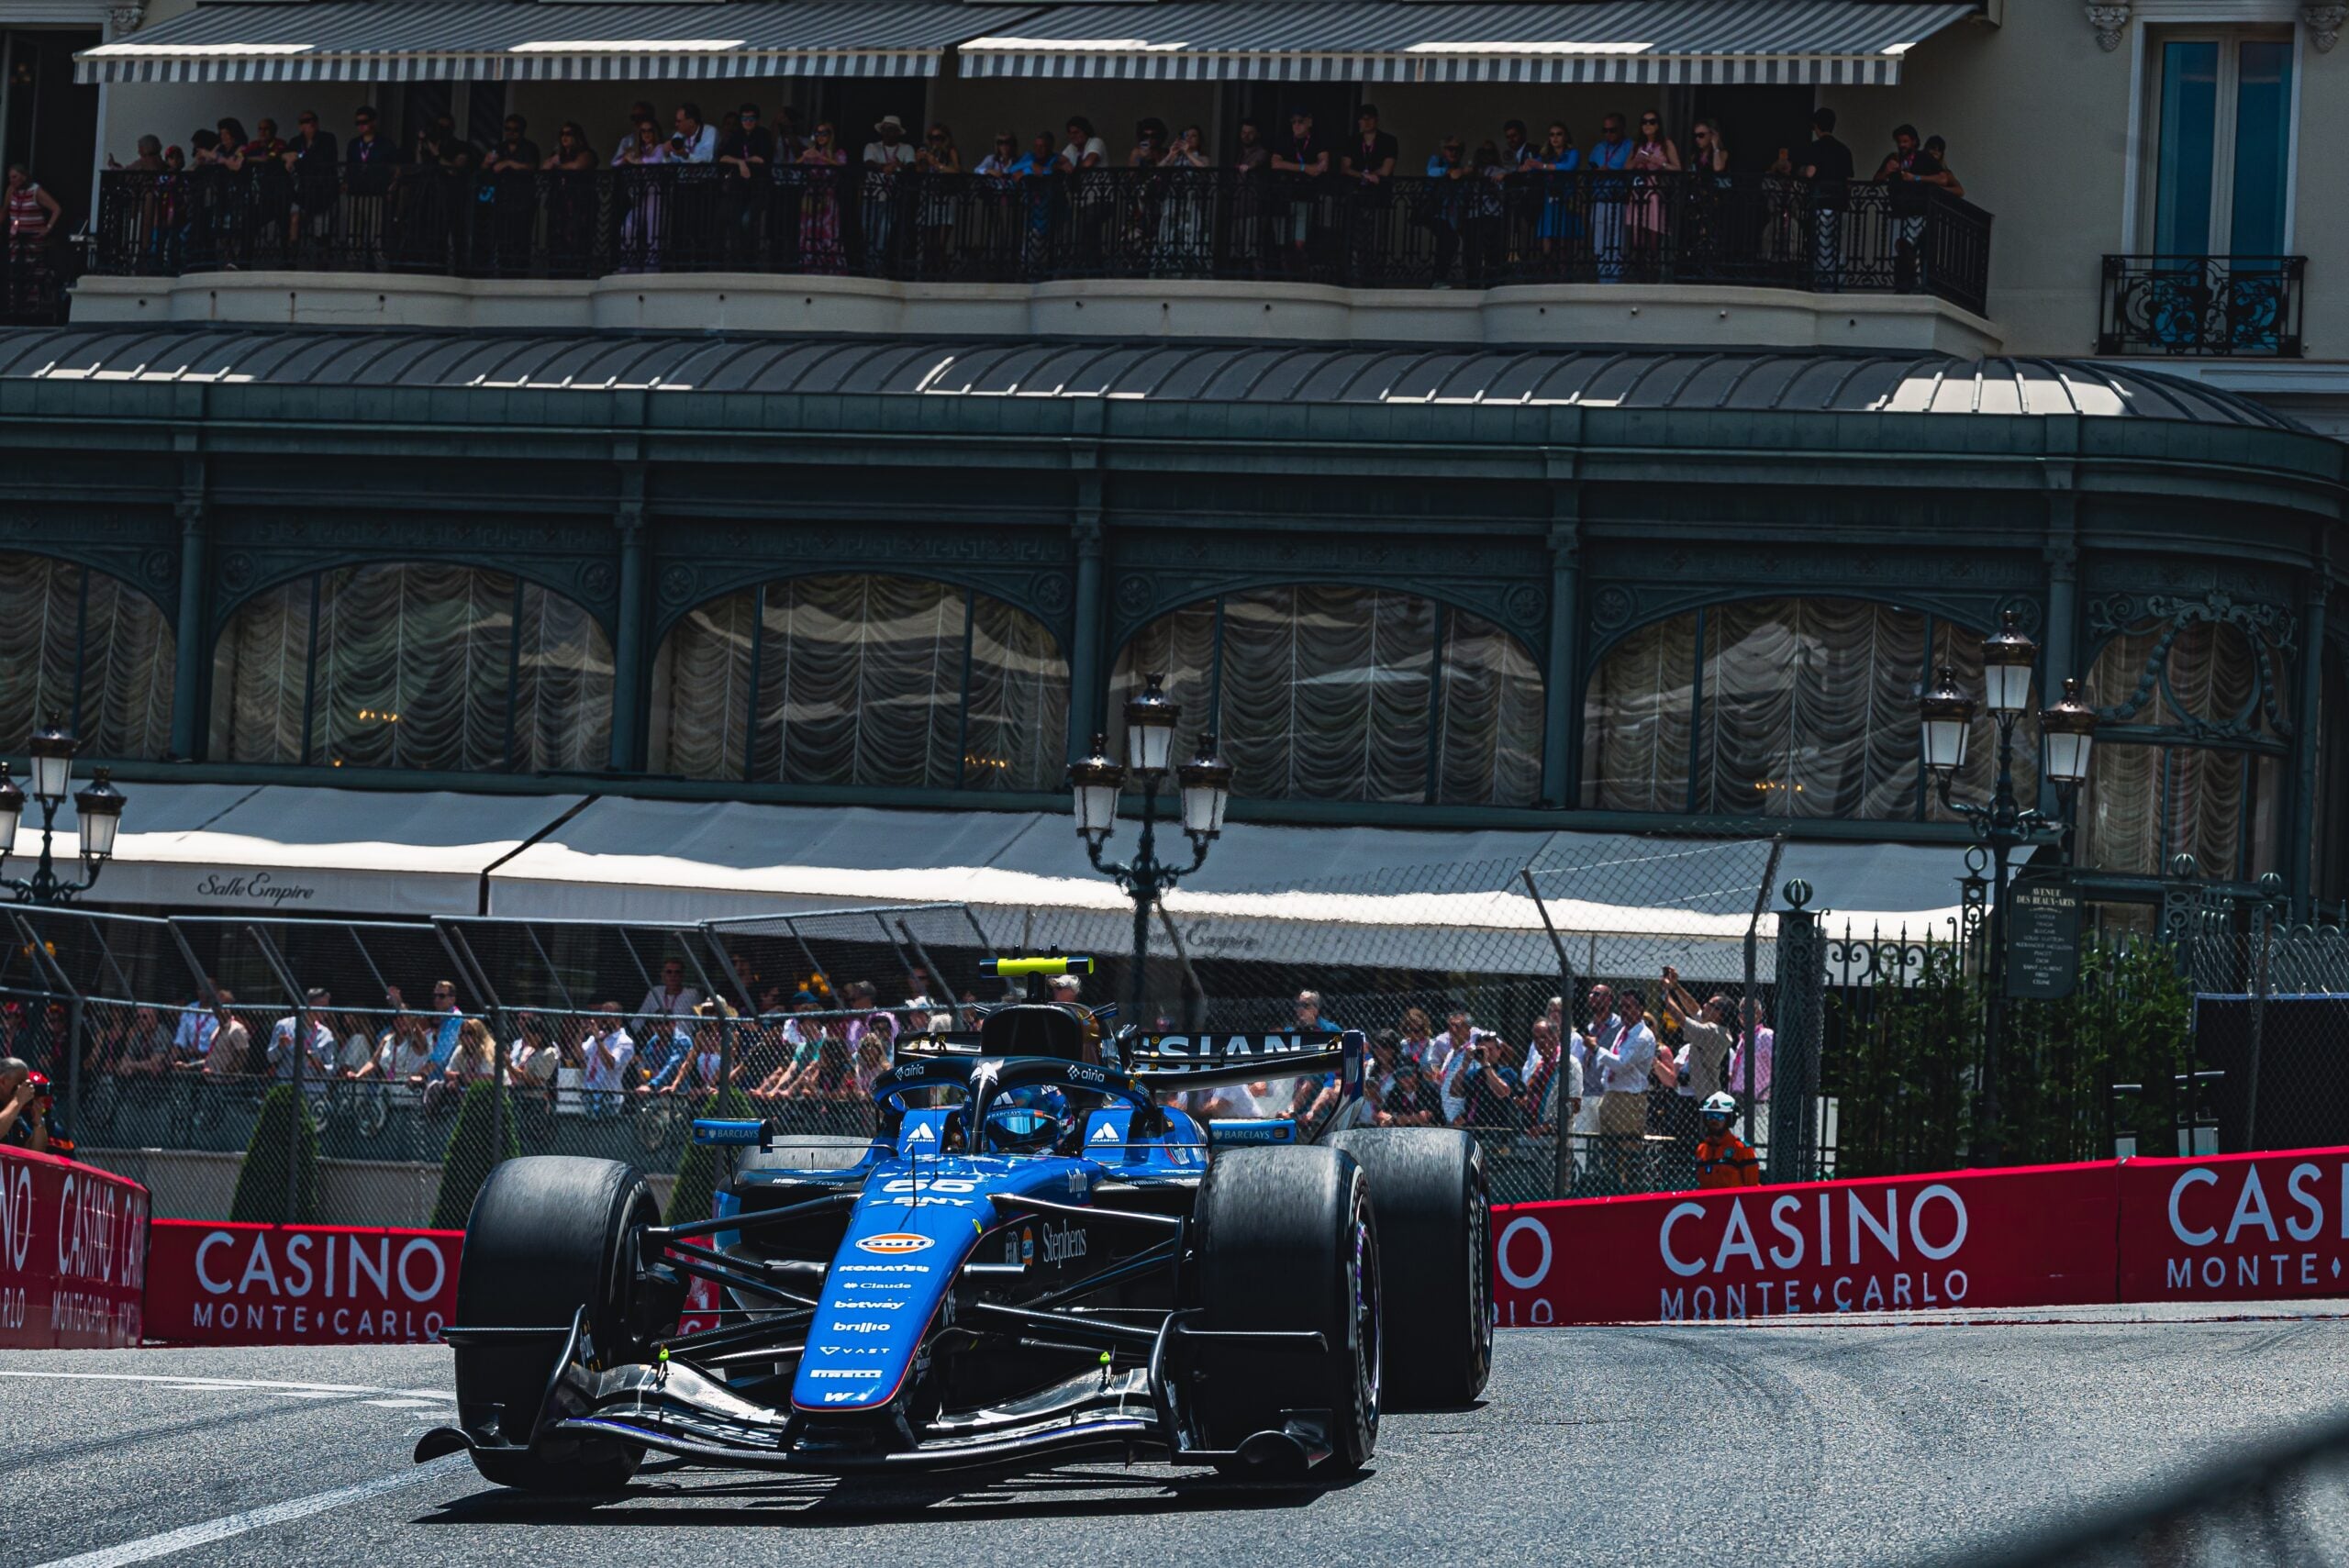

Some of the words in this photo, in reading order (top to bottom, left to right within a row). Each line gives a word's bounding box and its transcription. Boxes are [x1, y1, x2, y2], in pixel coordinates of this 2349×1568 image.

[196, 874, 245, 895] Salle
[247, 872, 315, 906] Empire
[2032, 888, 2061, 897] AVENUE
[2016, 895, 2031, 904] DES
[2032, 896, 2076, 906] BEAUX-ARTS
[904, 1063, 925, 1077] airia
[1081, 1068, 1105, 1083] airia
[718, 1129, 759, 1139] BARCLAYS
[1224, 1129, 1270, 1140] BARCLAYS
[882, 1179, 976, 1193] 55
[893, 1196, 974, 1207] BNY
[59, 1173, 115, 1277] CASINO
[1660, 1184, 1968, 1276] CASINO
[862, 1239, 929, 1249] Gulf
[1042, 1218, 1087, 1269] Stephens
[195, 1230, 446, 1302] CASINO
[839, 1264, 930, 1273] KOMATSU
[2167, 1253, 2319, 1288] MONTE
[1660, 1281, 1800, 1321] MONTE
[1833, 1270, 1968, 1311] CARLO
[51, 1290, 83, 1330] MONTE
[833, 1300, 906, 1309] betway
[193, 1302, 308, 1332] MONTE
[332, 1307, 444, 1339] CARLO
[832, 1322, 891, 1333] brillio
[809, 1369, 884, 1378] PIRELLI
